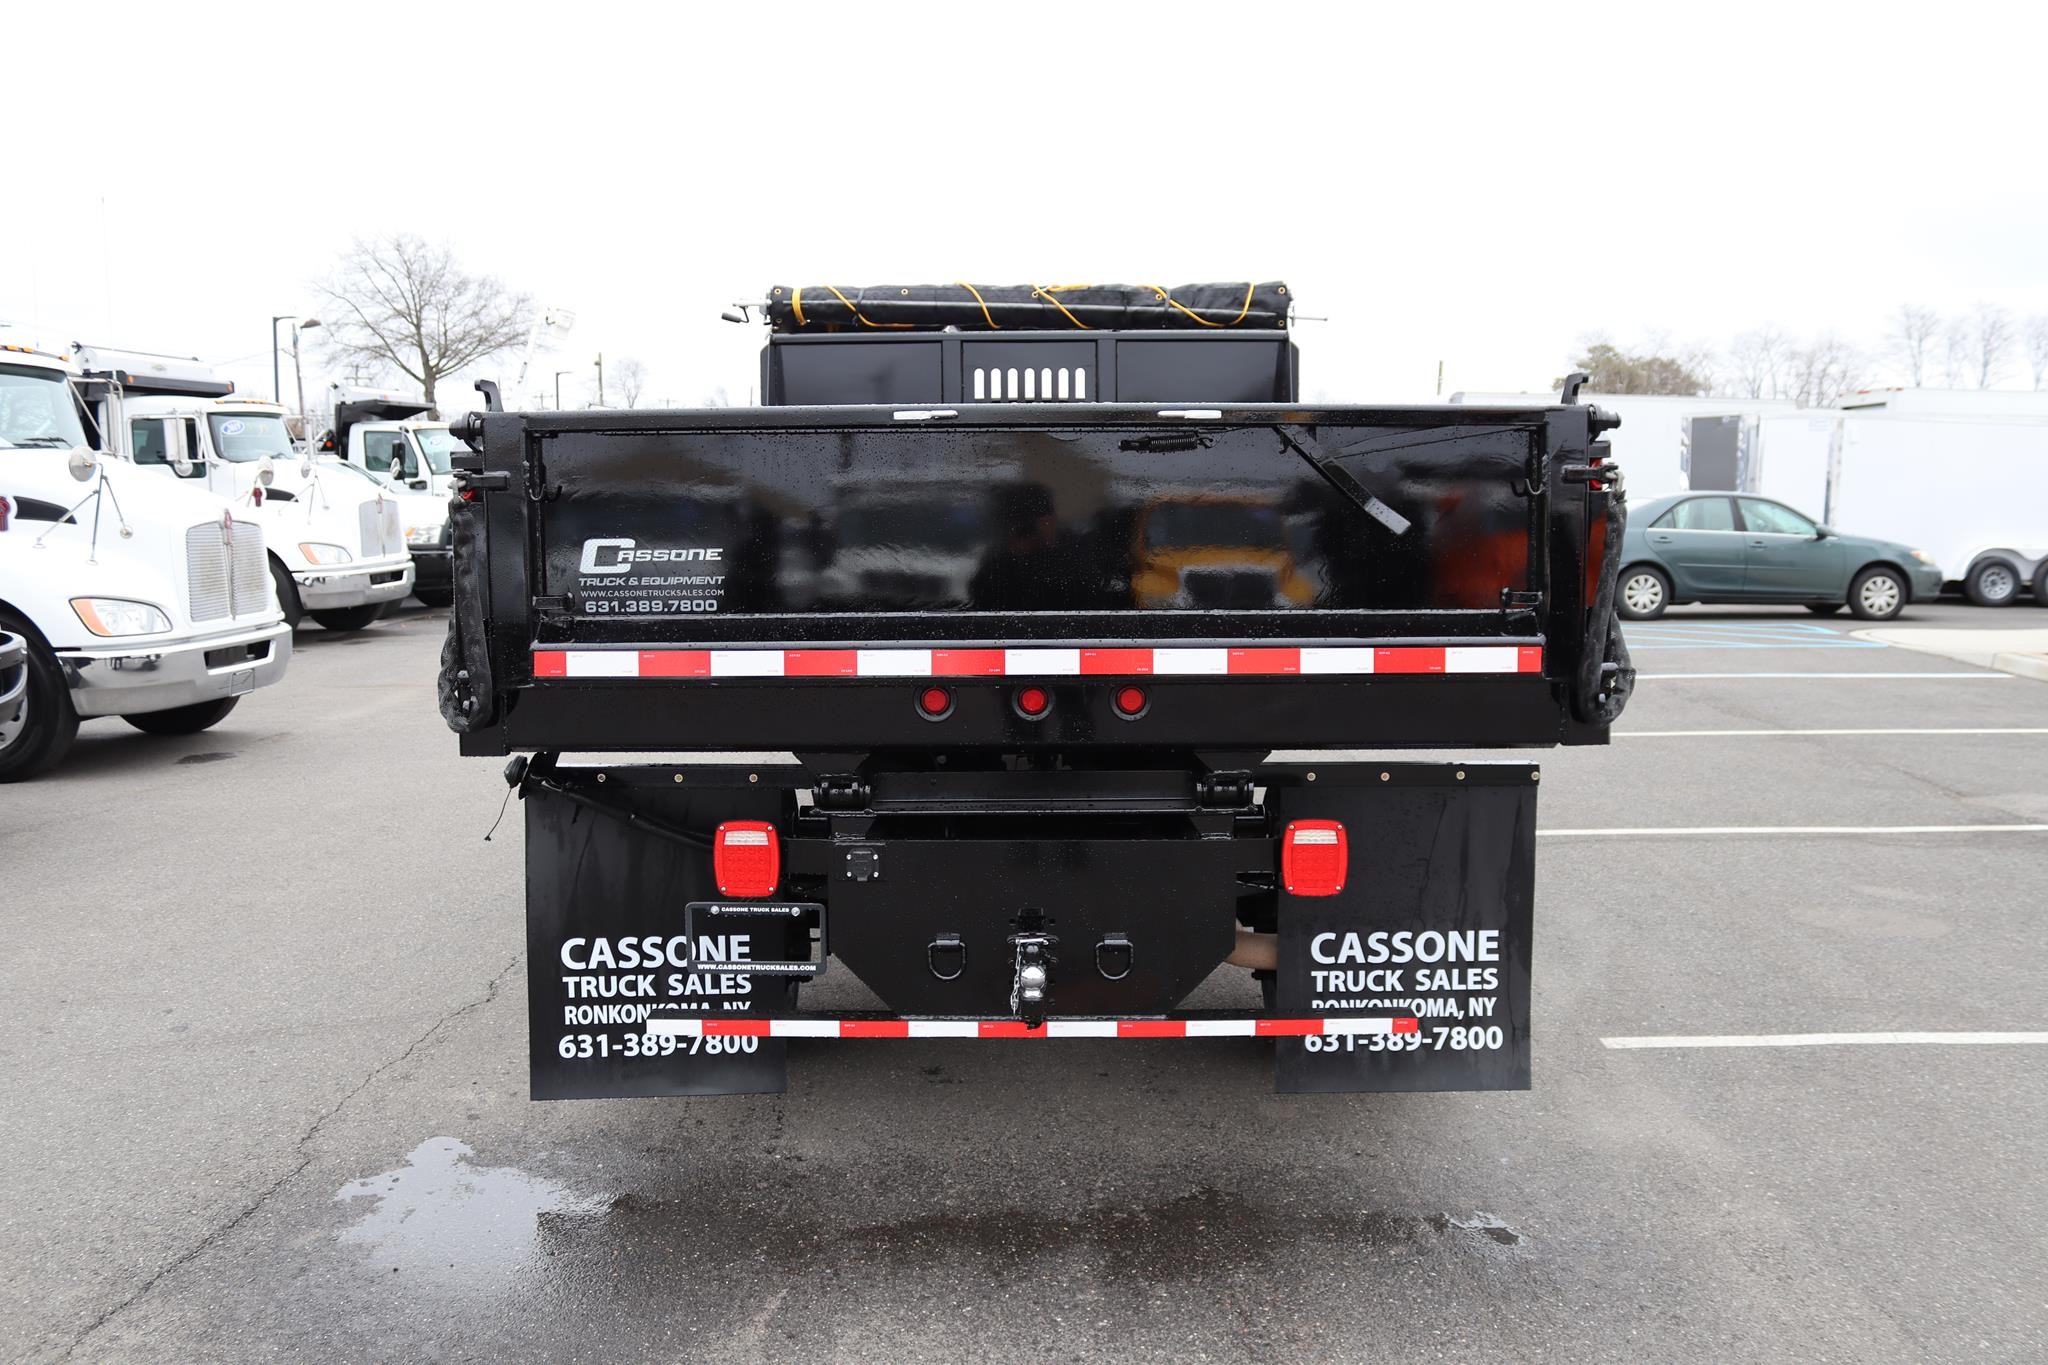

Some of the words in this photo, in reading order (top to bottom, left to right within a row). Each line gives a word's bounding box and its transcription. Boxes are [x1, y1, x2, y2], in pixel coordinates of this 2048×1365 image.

[579, 577, 626, 586] TRUCK
[628, 577, 639, 586] &
[641, 576, 726, 586] EQUIPMENT
[580, 589, 725, 598] WWW.CASSONETRUCKSALES.COM
[585, 599, 718, 613] 631.389.7800
[560, 935, 751, 970] CASSONE
[1310, 930, 1500, 964] CASSONE
[697, 963, 817, 972] WWW.CASSONETRUCKSALES.COM
[562, 974, 656, 998] TRUCK
[667, 974, 752, 996] SALES
[1311, 970, 1404, 993] TRUCK
[1415, 968, 1499, 992] SALES
[564, 1003, 711, 1025] RONKON
[1469, 997, 1498, 1017] NY
[558, 1033, 760, 1059] 631-389-7800
[1304, 1026, 1504, 1053] 631-389-7800
